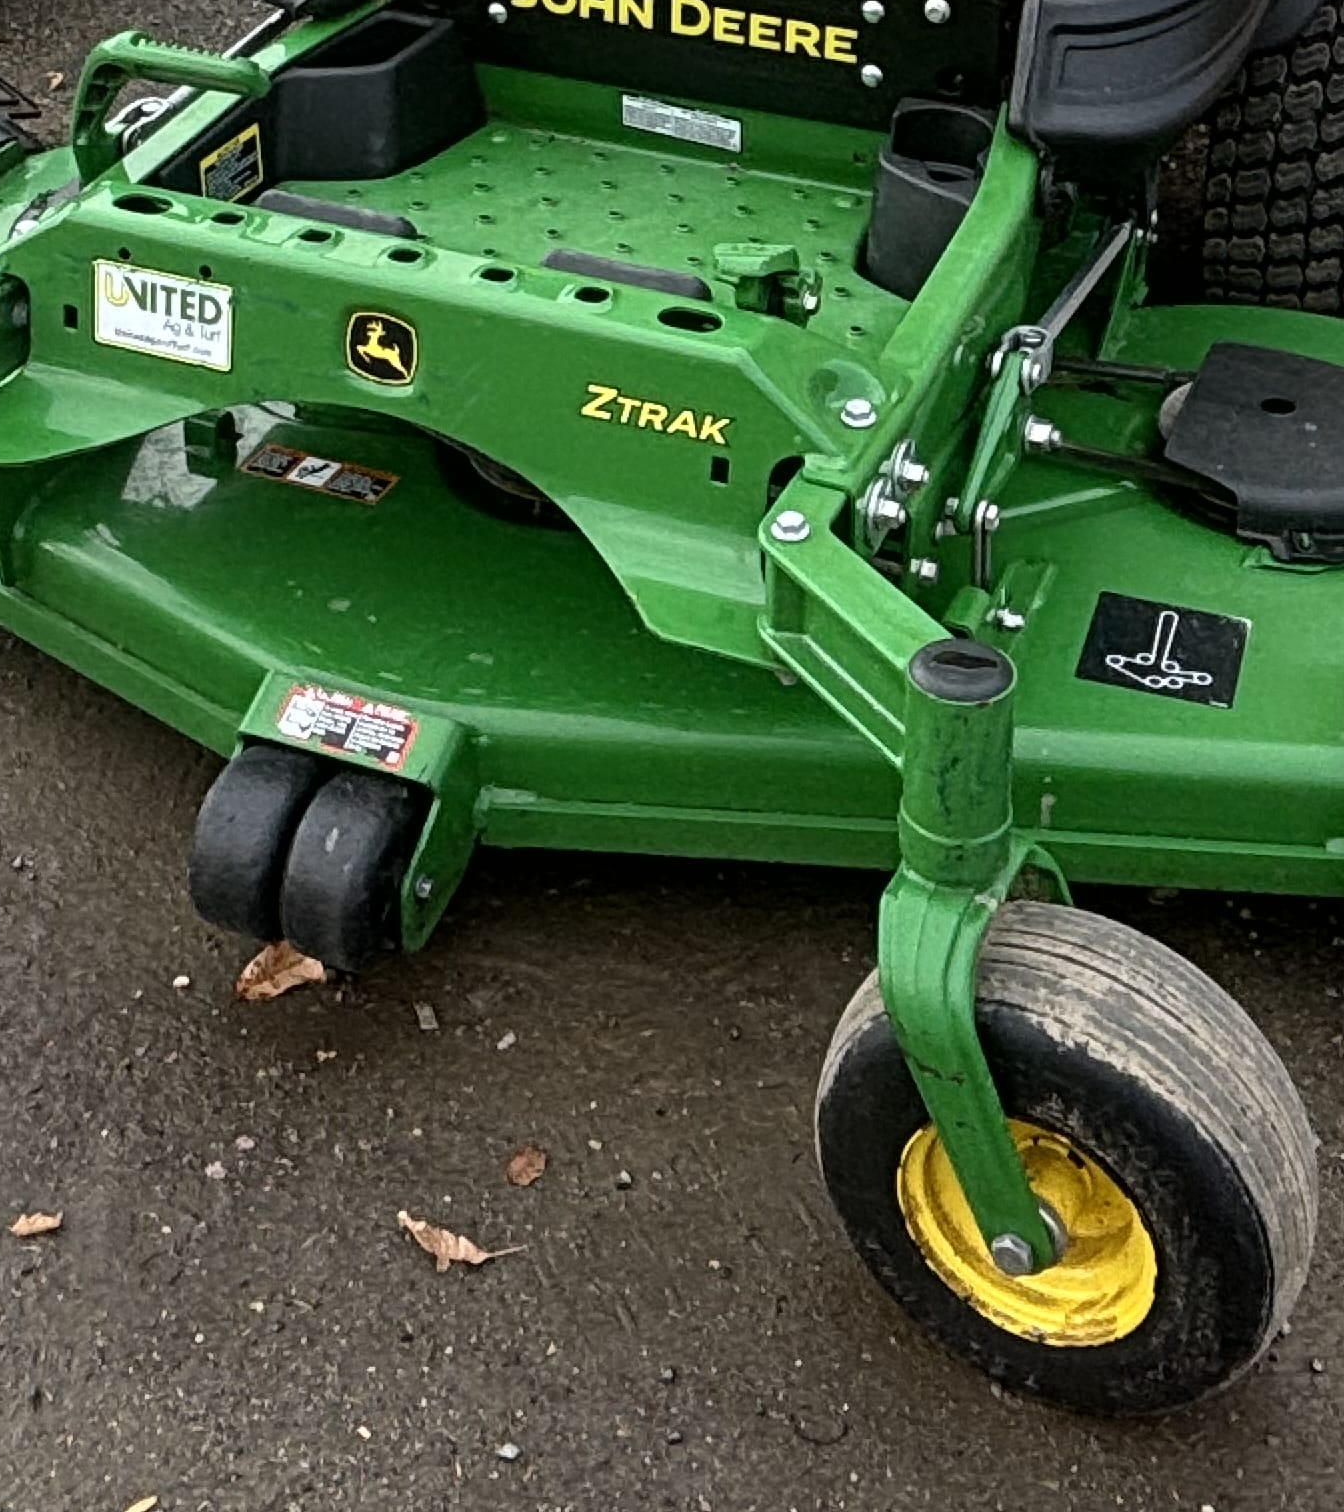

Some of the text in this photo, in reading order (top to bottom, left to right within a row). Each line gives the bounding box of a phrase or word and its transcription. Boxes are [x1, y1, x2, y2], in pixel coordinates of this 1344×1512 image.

[105, 272, 223, 326] UNITED
[162, 319, 182, 336] Ag
[184, 324, 195, 337] &
[200, 325, 222, 343] Turf
[580, 384, 731, 445] ZTRAK
